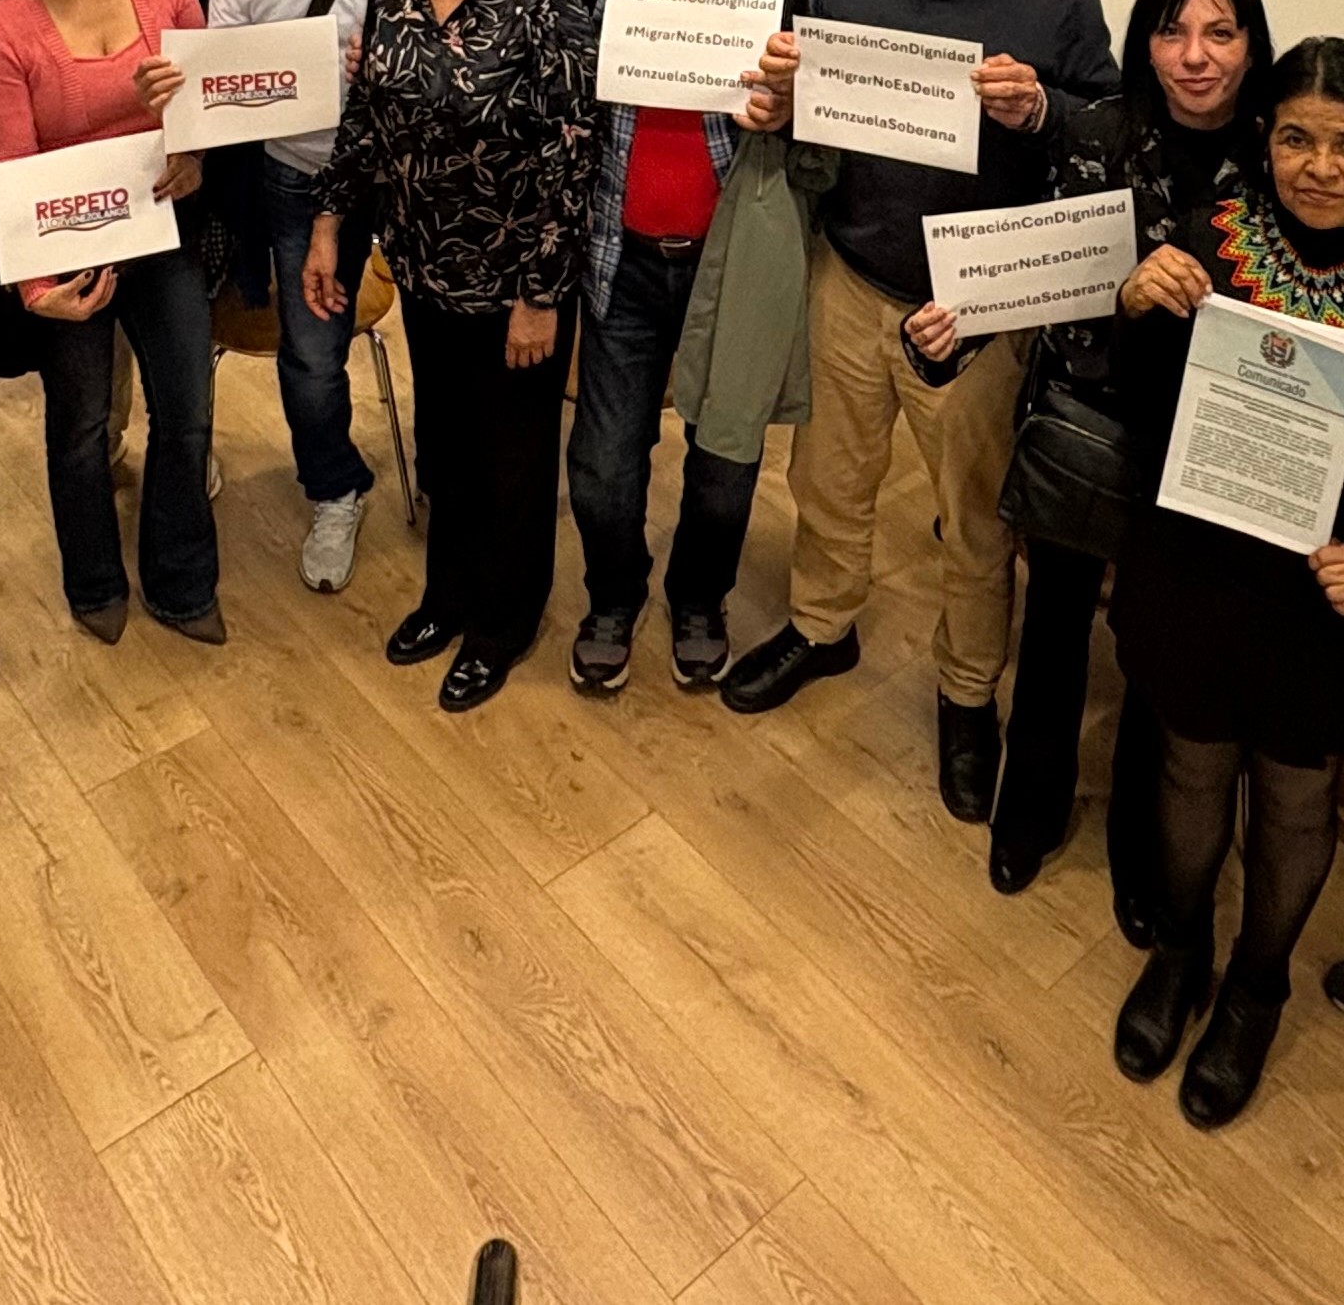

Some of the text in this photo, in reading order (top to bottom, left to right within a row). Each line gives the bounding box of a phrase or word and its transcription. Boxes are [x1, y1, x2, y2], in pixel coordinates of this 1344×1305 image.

[626, 26, 754, 49] #MigrarNoEsDelito
[800, 27, 976, 64] #MigraciónConDignidad
[202, 70, 296, 95] RESPETO
[820, 67, 955, 100] #MigrarNoEsDelito
[814, 106, 956, 143] #VenzuelaSoberana
[35, 188, 128, 220] RESPETO
[932, 201, 1126, 239] #MigraciónConDignidad
[959, 245, 1108, 279] #MigrarNoEsDelito
[959, 281, 1116, 316] #VenzuelaSoberana
[1237, 364, 1306, 398] Comunicado
